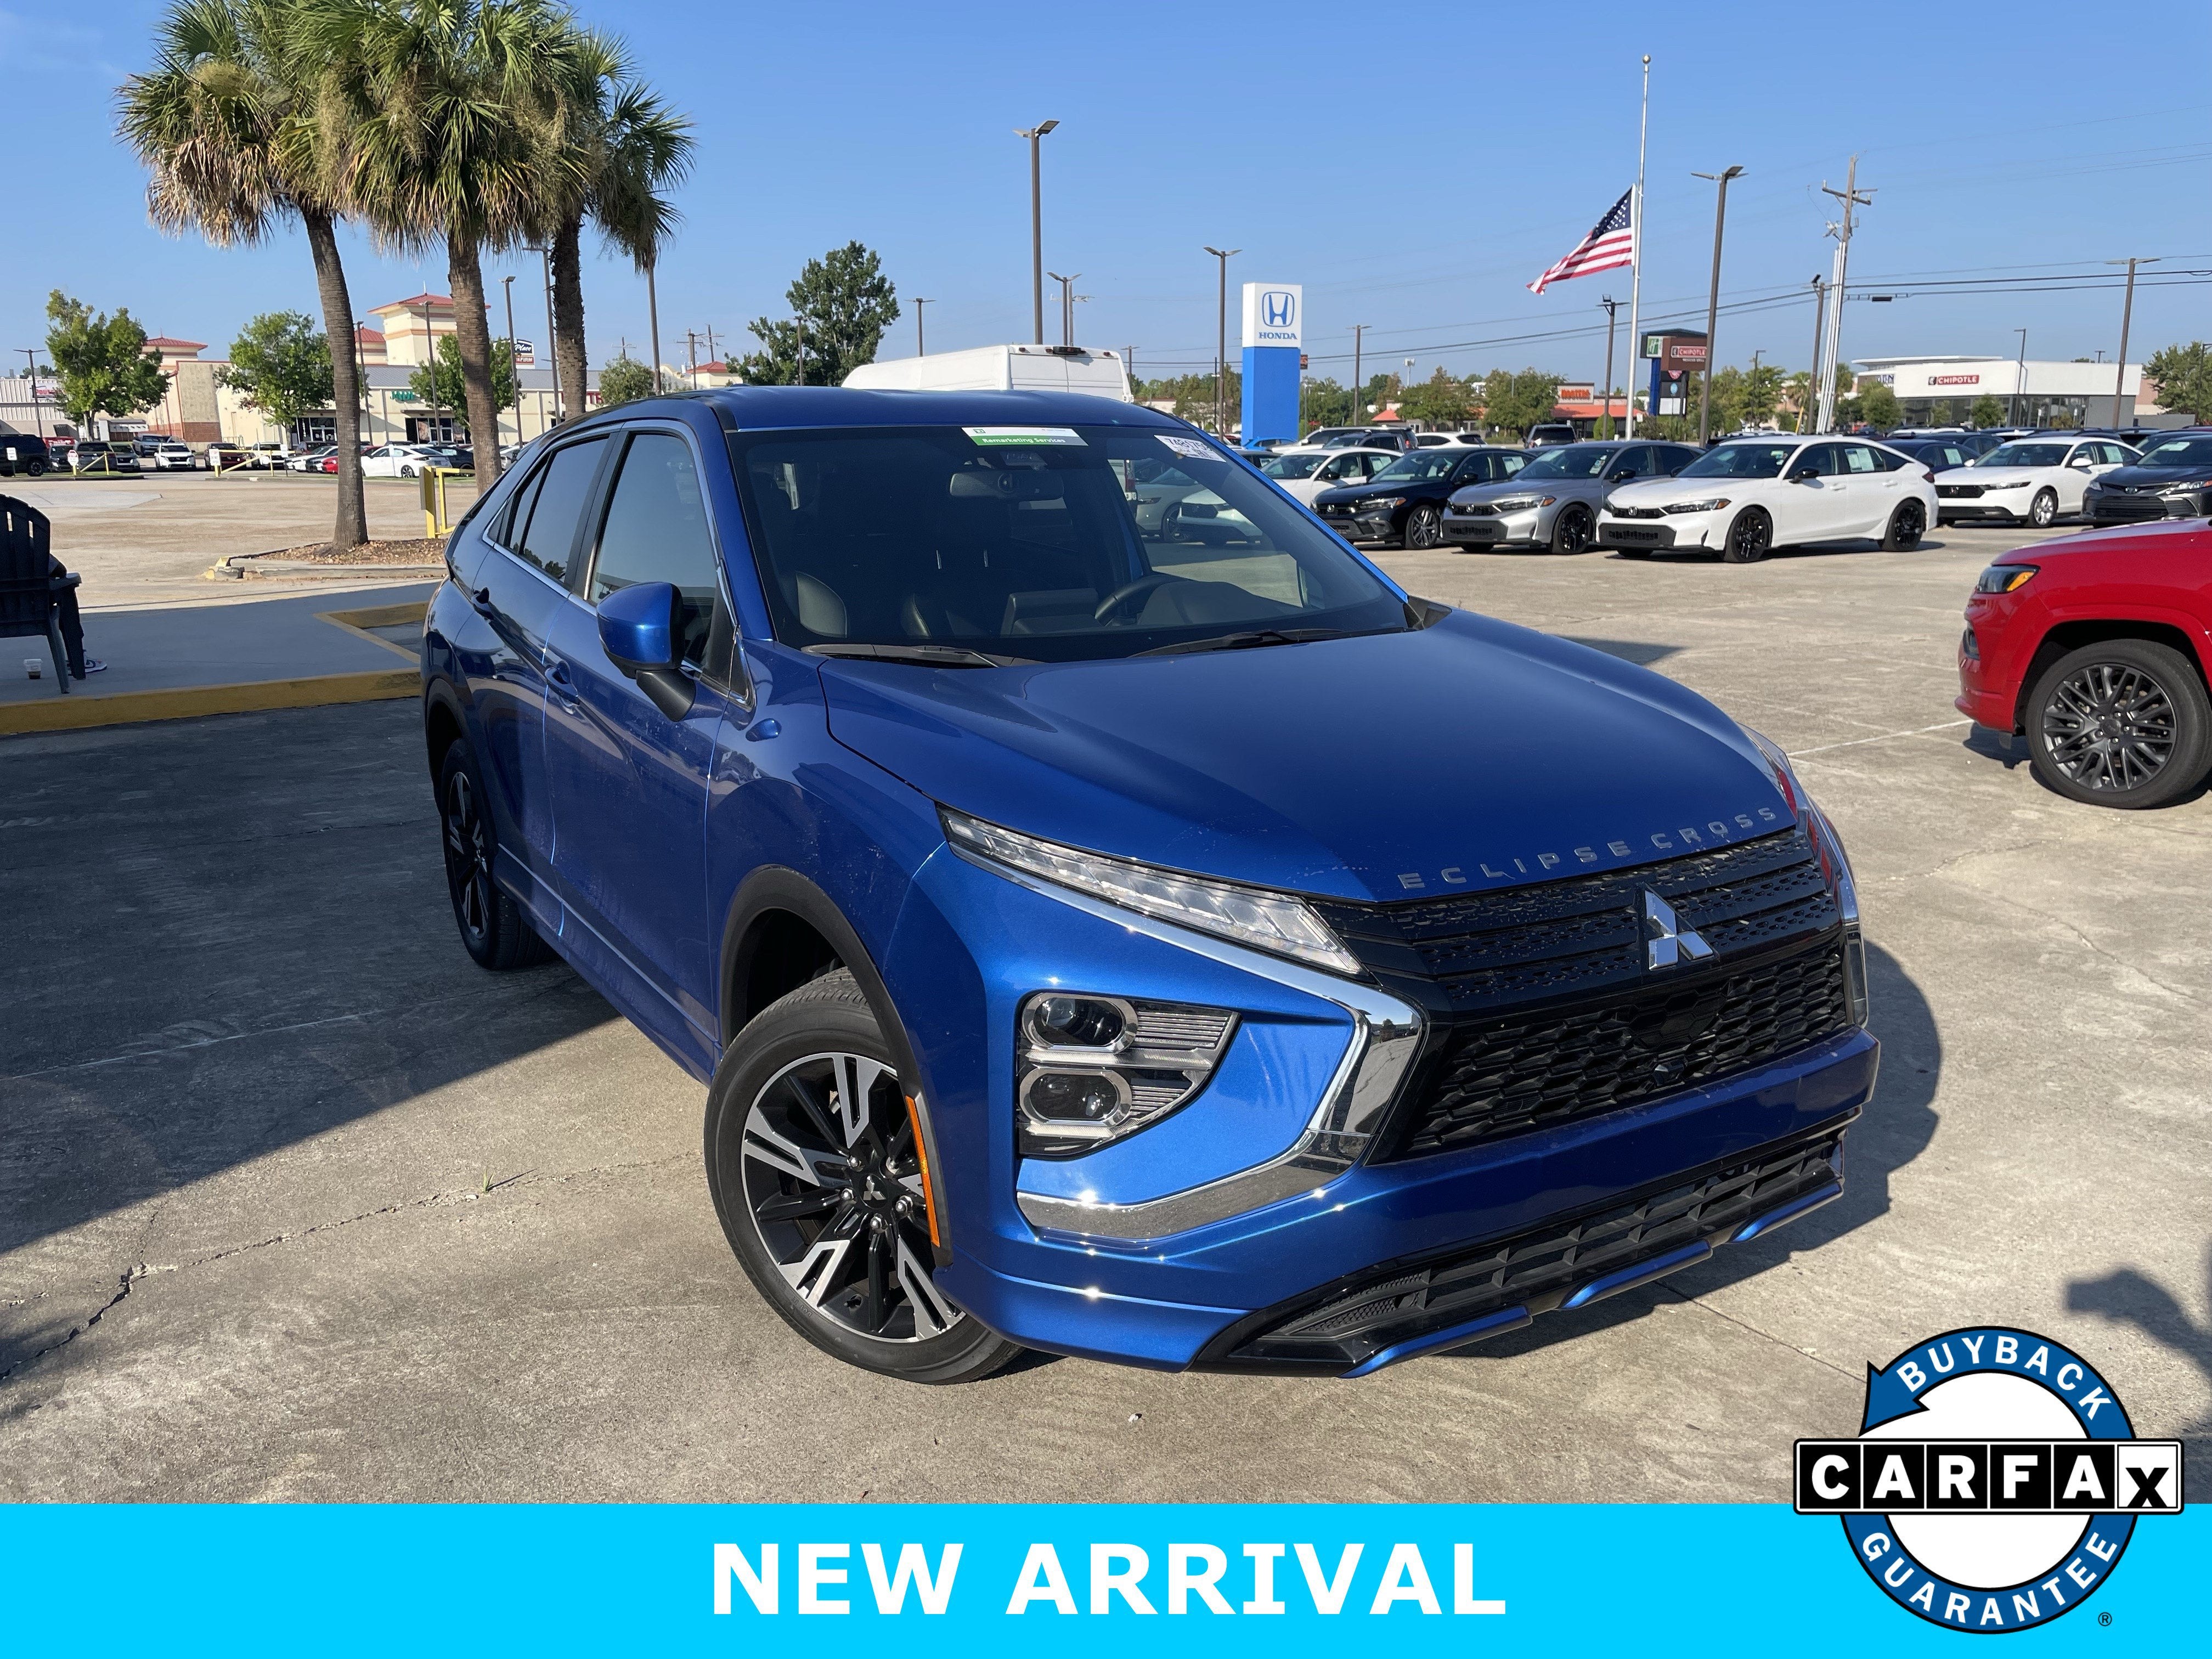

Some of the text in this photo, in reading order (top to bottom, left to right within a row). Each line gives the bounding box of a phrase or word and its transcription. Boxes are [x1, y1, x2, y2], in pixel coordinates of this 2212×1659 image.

[1938, 376, 1977, 384] CHIPOTLE
[1397, 806, 1777, 889] ECLIPSE CROSS
